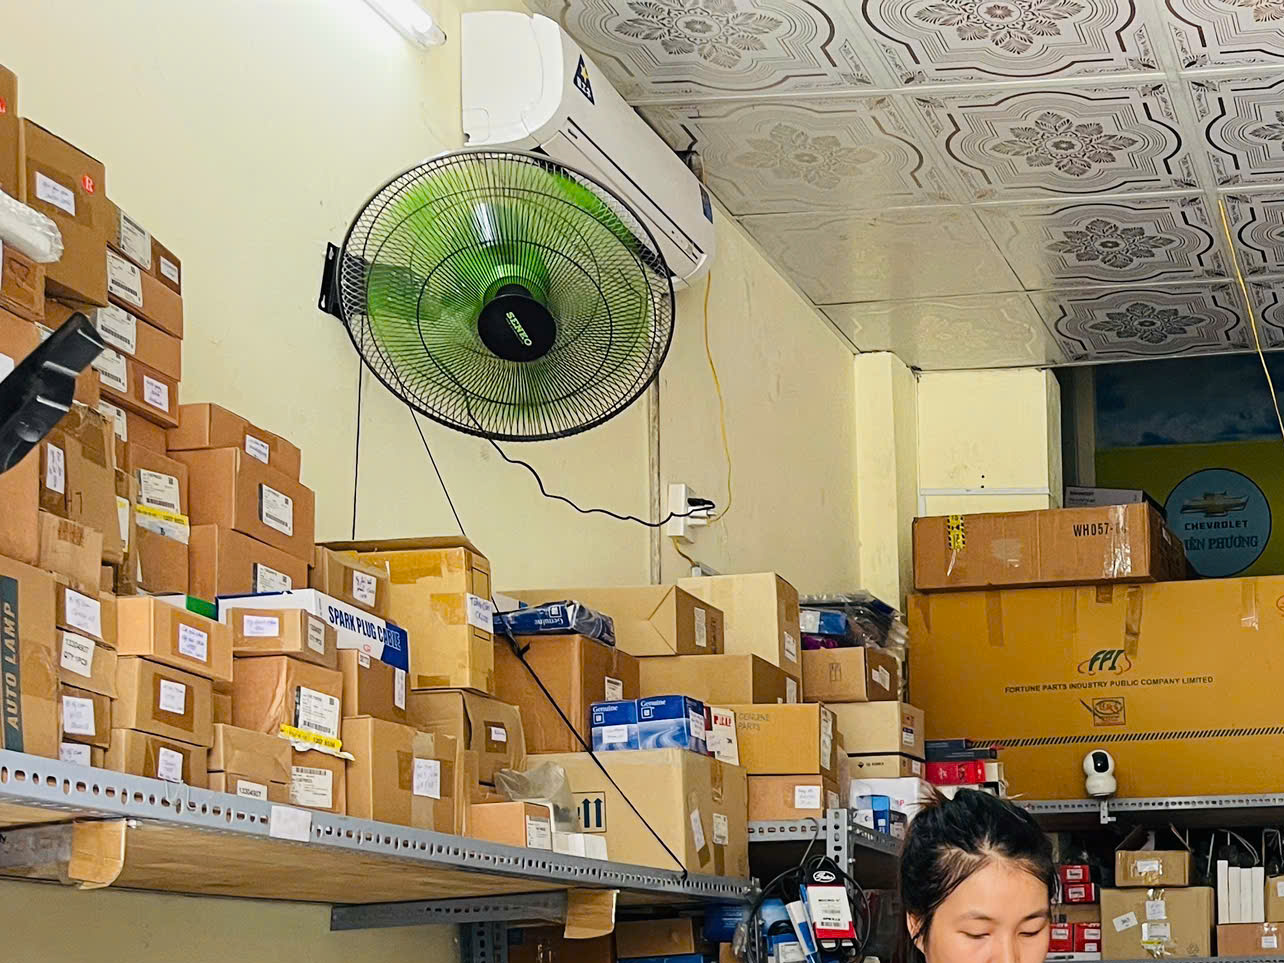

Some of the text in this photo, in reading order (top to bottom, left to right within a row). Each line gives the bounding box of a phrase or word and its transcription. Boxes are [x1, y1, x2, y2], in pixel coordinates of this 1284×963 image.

[505, 311, 533, 346] SENKO
[1184, 519, 1249, 531] CHEVROLET
[1208, 534, 1259, 551] PHƯƠNG
[328, 605, 401, 650] SPARK PLUG CABLE
[4, 602, 19, 730] AUTO LAMP
[1005, 676, 1213, 693] FORTUNE PARTS INDUSTRY PUBLIC COMPANY LIMITED
[592, 705, 618, 713] Genuine
[640, 699, 666, 707] Genuine
